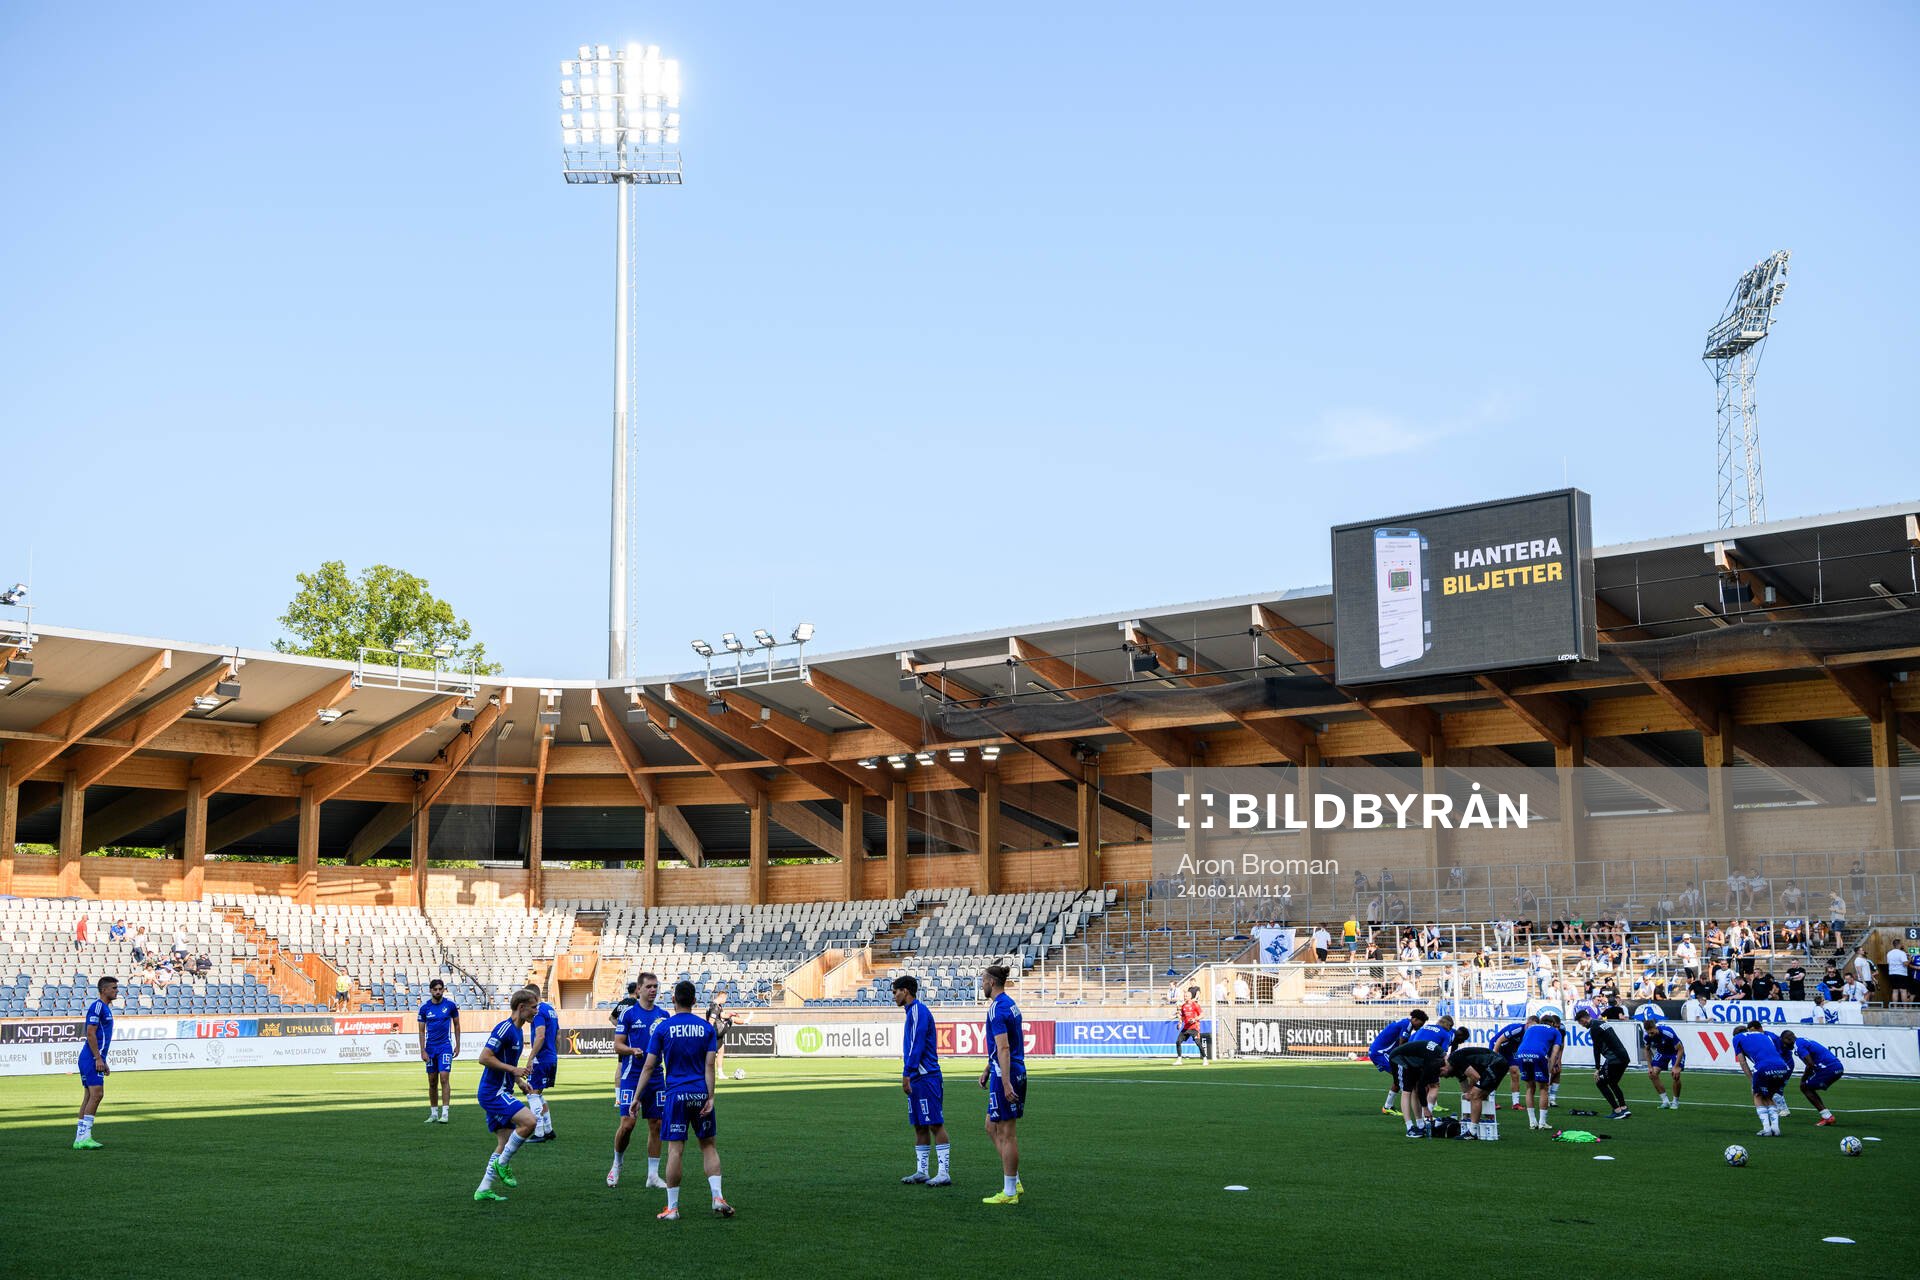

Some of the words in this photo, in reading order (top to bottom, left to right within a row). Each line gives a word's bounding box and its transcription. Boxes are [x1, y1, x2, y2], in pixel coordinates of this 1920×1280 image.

[1454, 537, 1562, 570] HANTERA
[1443, 562, 1562, 596] BILJETTER
[1910, 929, 1917, 939] 8
[18, 1025, 75, 1038] NORDIC
[196, 1020, 240, 1039] UFS
[286, 1025, 318, 1034] UPSALA
[320, 1024, 333, 1033] GK
[344, 1022, 392, 1031] Luthagens
[670, 1025, 705, 1038] PEKING
[1240, 1022, 1282, 1053] BOA
[1287, 1029, 1332, 1043] SKIVOR
[1336, 1029, 1362, 1043] TILL
[152, 1053, 195, 1061] KRISTINA
